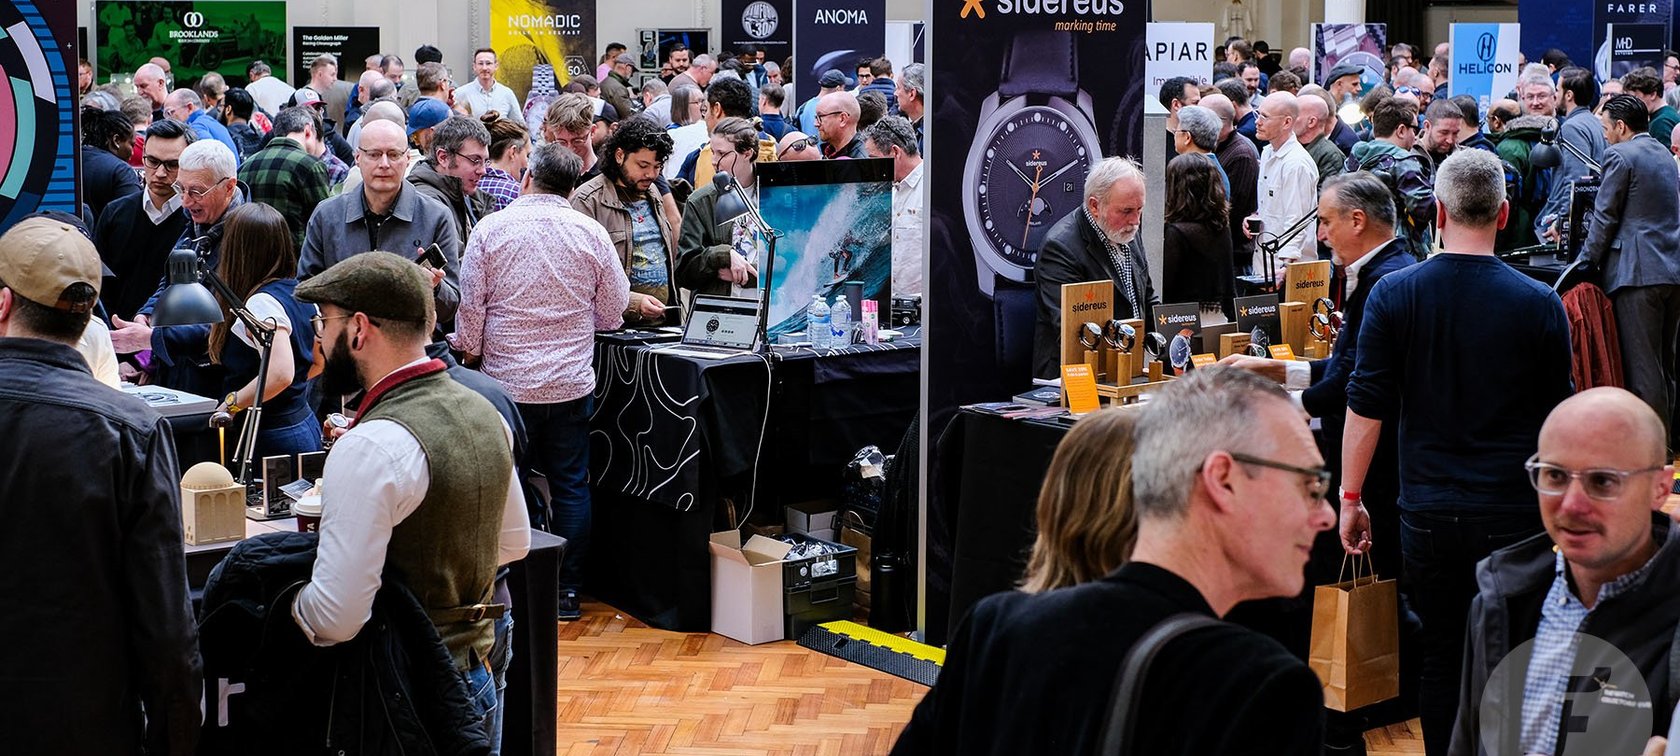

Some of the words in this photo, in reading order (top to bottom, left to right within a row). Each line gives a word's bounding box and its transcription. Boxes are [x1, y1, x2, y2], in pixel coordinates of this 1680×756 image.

[1607, 3, 1657, 13] FARER
[508, 14, 580, 28] NOMADIC
[814, 9, 868, 24] ANOMA
[1054, 19, 1094, 34] marking
[1095, 20, 1117, 32] time
[168, 30, 219, 38] BROOKLANDS
[1615, 36, 1633, 49] MHD
[567, 65, 580, 76] 50
[1295, 279, 1325, 290] sidereus
[1072, 300, 1107, 313] sidereus
[1248, 305, 1276, 315] sidereus
[1168, 313, 1197, 324] sidereus
